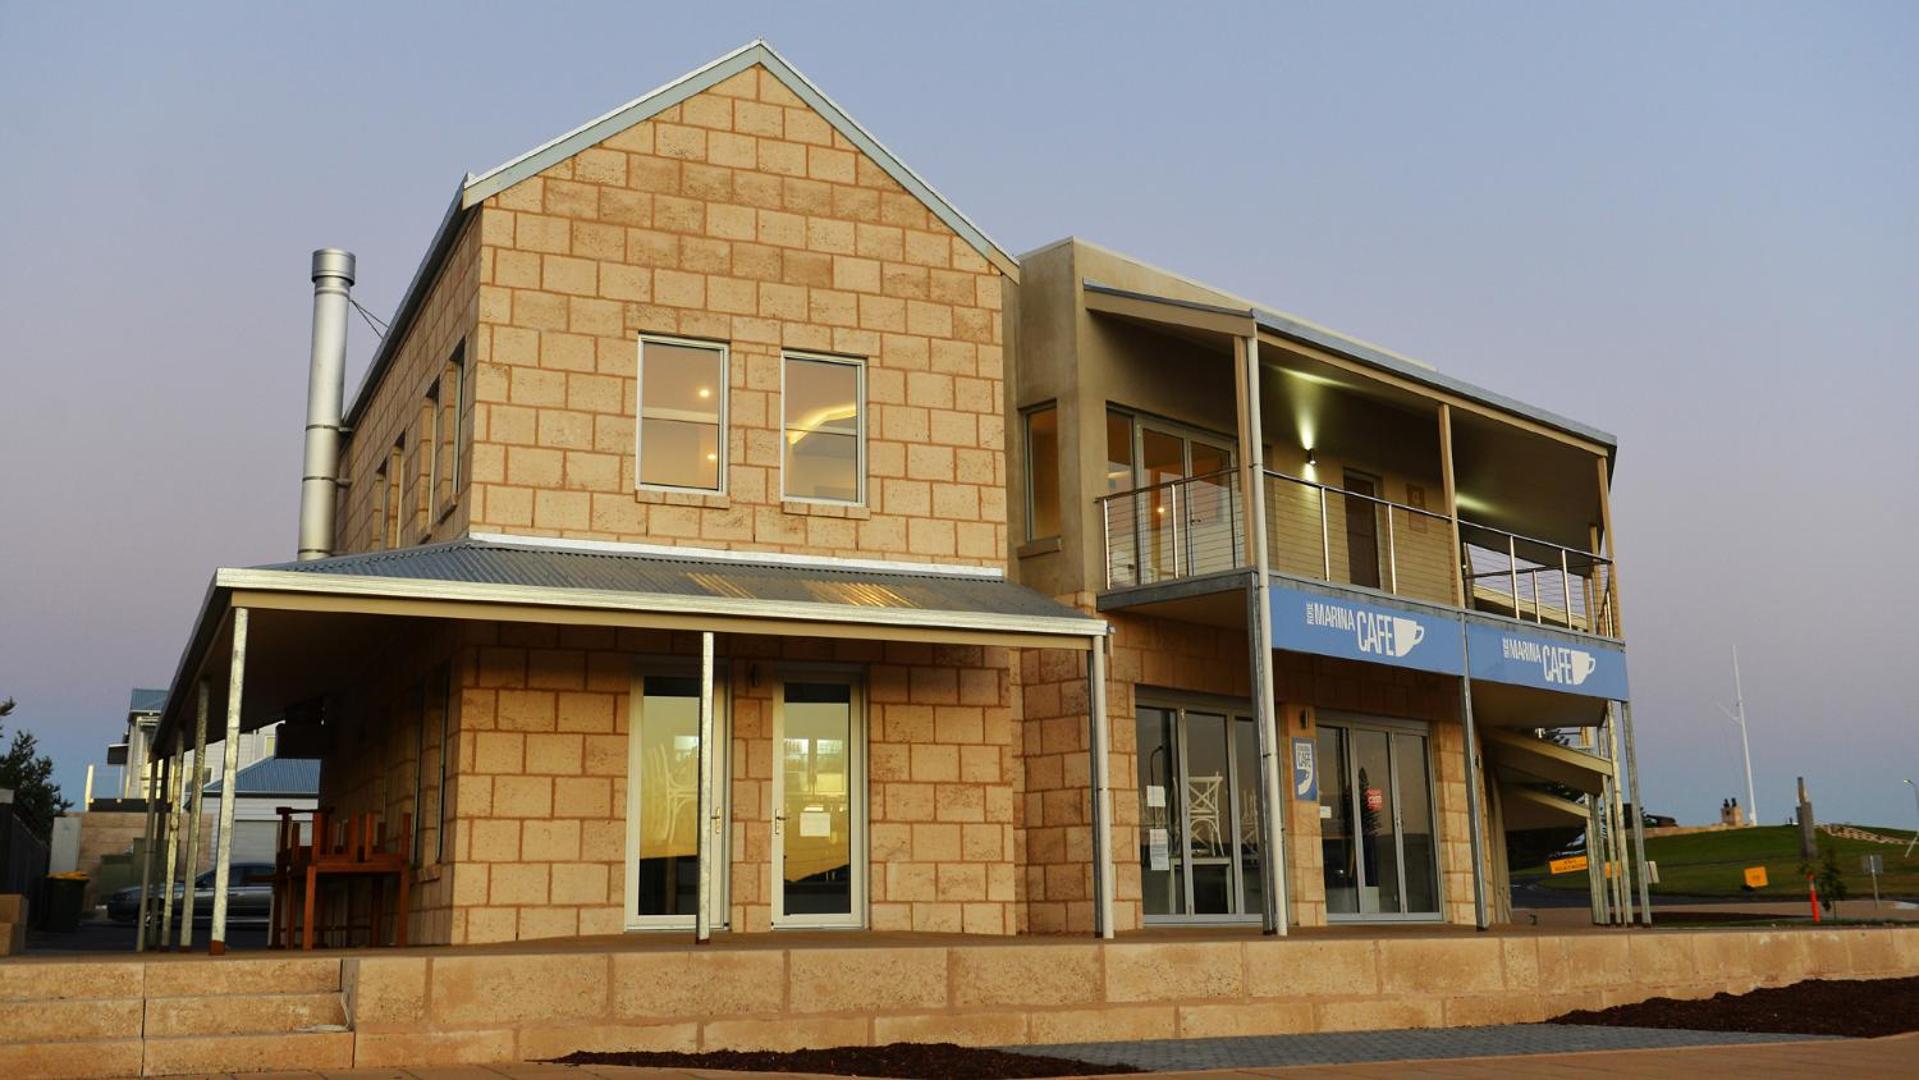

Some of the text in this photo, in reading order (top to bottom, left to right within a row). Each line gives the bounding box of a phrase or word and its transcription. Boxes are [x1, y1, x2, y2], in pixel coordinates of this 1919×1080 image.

[1314, 603, 1356, 632] MARINA
[1356, 610, 1394, 656] CAFE
[1510, 639, 1543, 664] MARINA
[1542, 644, 1572, 685] CAFE
